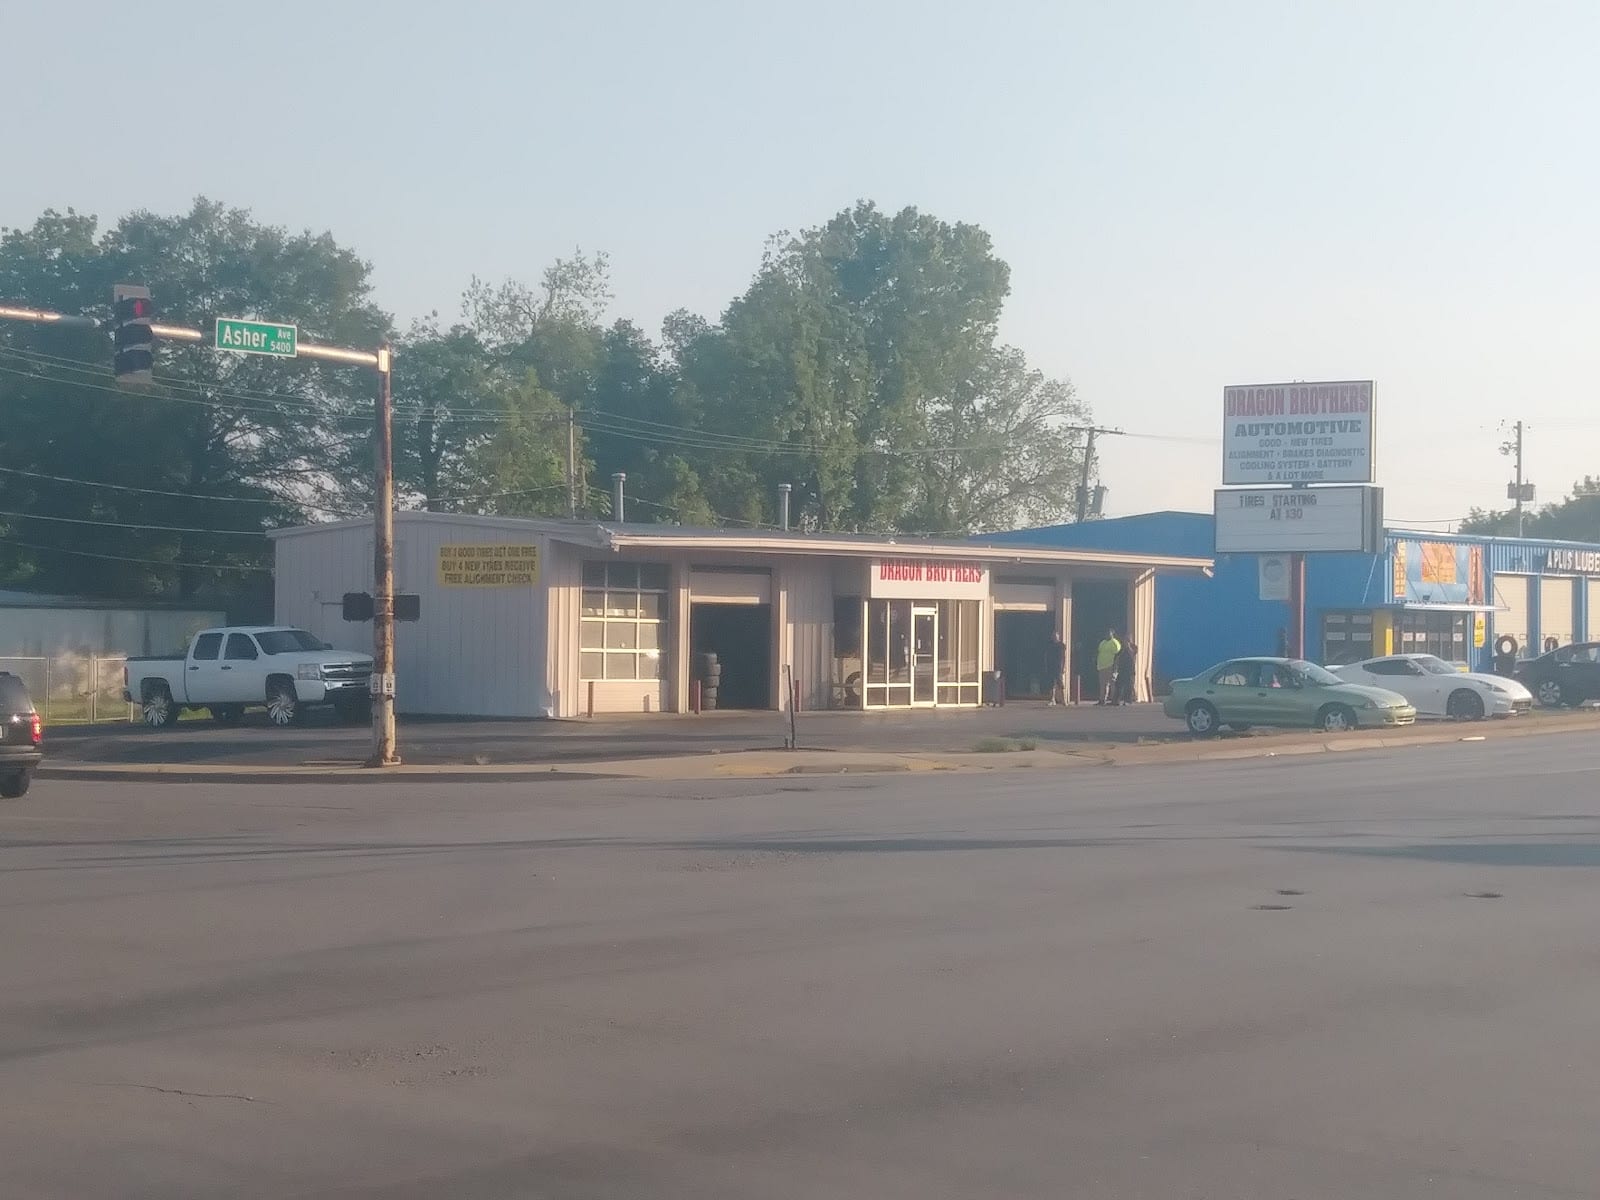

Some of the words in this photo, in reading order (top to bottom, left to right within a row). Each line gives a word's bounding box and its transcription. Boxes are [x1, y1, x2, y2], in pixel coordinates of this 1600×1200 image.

[223, 325, 268, 348] Asher
[277, 329, 291, 340] Ave
[270, 341, 291, 353] 5400
[1227, 388, 1285, 417] DRAGON
[1289, 383, 1369, 415] BROTHERS
[1234, 419, 1362, 437] AUTOMOTIVE
[1258, 438, 1282, 448] GOOD
[1290, 437, 1308, 447] NEW
[1310, 436, 1334, 446] TIRES
[1228, 450, 1274, 459] ALIGNMENT
[1282, 448, 1314, 458] BRAKES
[1239, 461, 1276, 470] COOLING
[1277, 460, 1310, 469] SYSTEM
[1317, 459, 1353, 469] BATTERY
[1275, 471, 1282, 480] A
[1283, 471, 1299, 480] LOT
[1301, 470, 1325, 480] MORE
[1239, 495, 1265, 508] TIRES
[1272, 494, 1318, 507] STARTING
[1269, 508, 1282, 520] AT
[441, 560, 457, 571] BUY
[464, 560, 481, 571] NEW
[1547, 549, 1553, 569] A
[1553, 549, 1573, 570] PLUS
[1575, 551, 1600, 572] LUBE
[444, 573, 463, 584] FREE
[880, 561, 922, 581] DRAGON
[926, 561, 982, 584] BROTHERS
